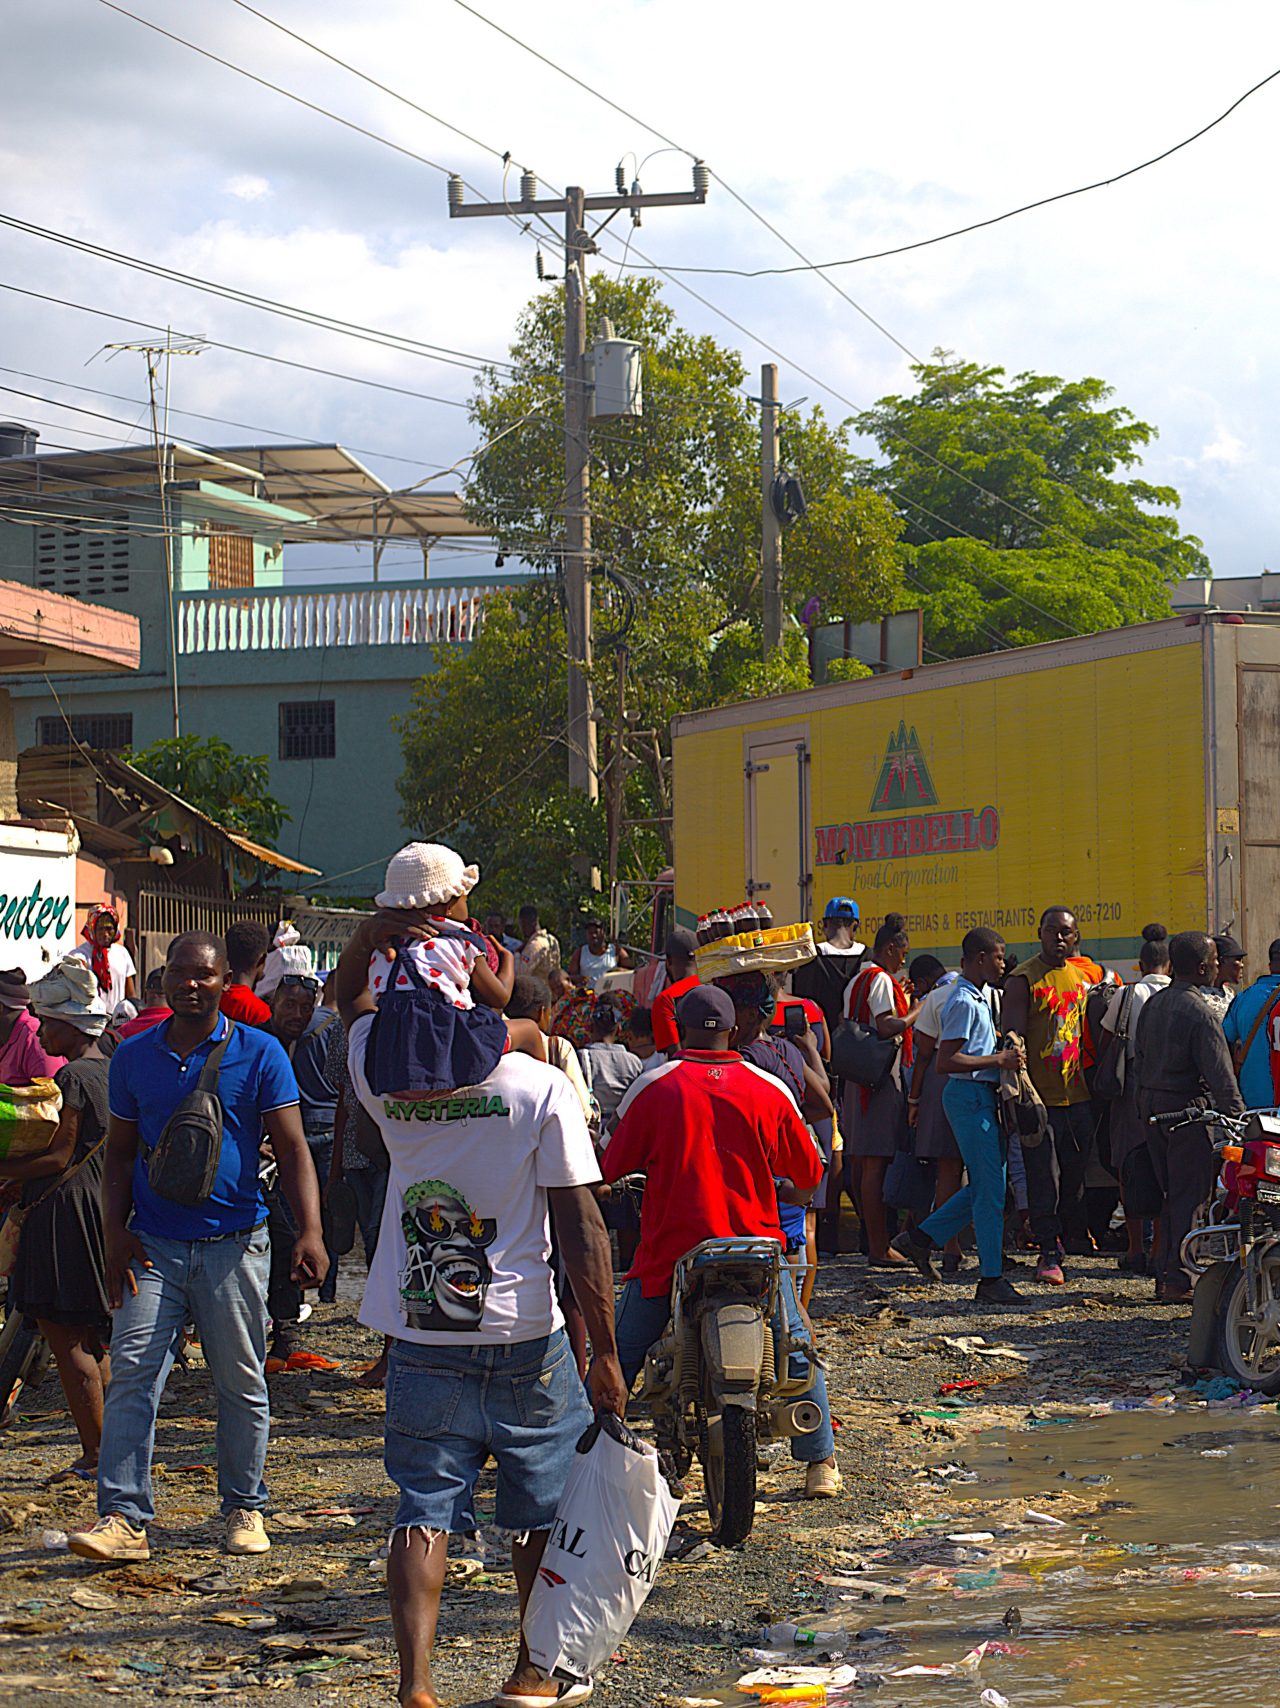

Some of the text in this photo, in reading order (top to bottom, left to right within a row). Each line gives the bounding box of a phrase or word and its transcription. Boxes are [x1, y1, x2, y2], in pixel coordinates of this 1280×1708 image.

[816, 807, 998, 864] MONTEBELLO
[853, 857, 959, 896] Food Corporation
[955, 907, 1035, 930] RESTAURANTS
